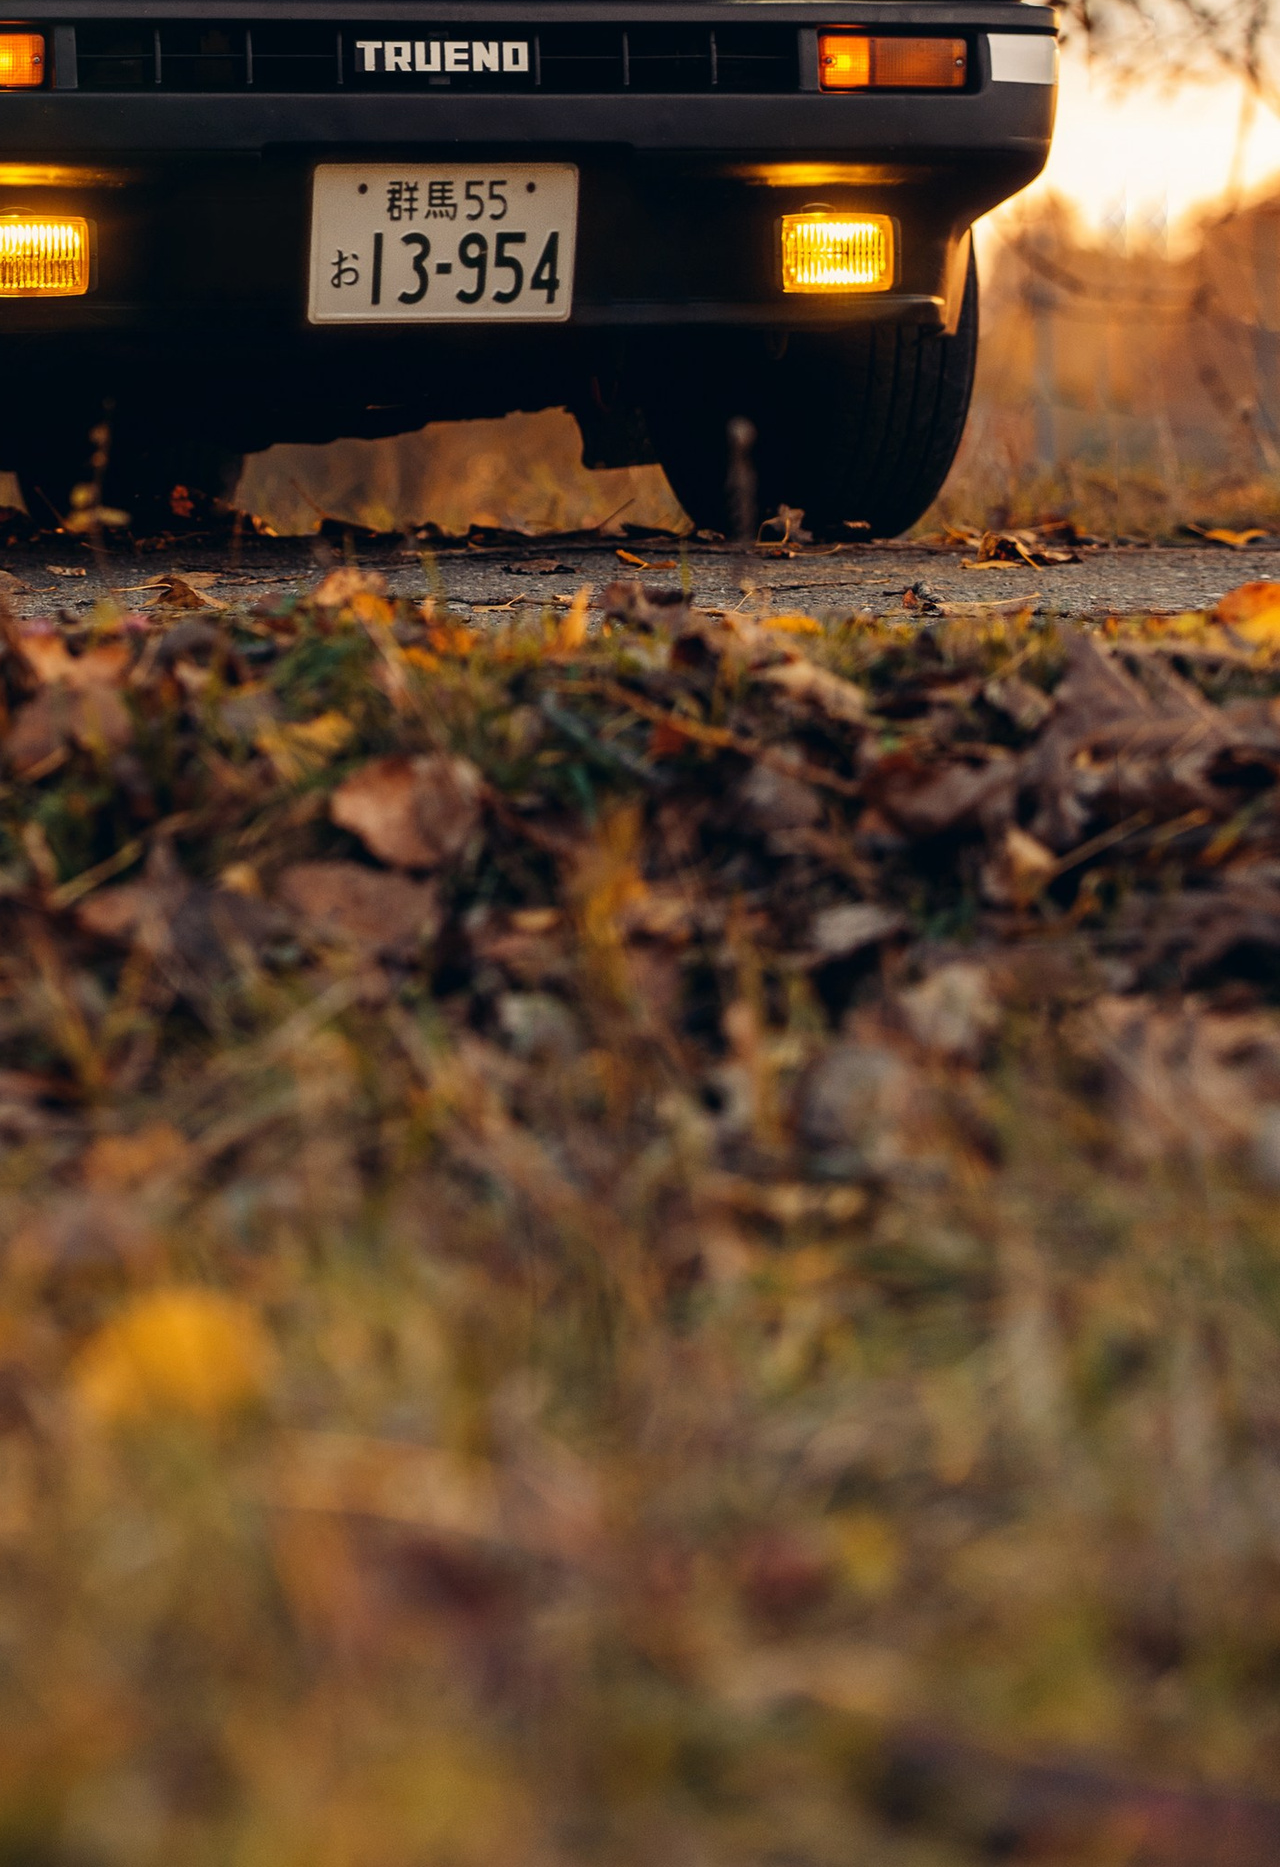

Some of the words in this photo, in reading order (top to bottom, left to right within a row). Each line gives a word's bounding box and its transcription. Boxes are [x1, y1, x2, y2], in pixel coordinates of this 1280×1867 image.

[356, 41, 529, 72] TRUENO
[386, 180, 508, 221] 群馬55
[330, 249, 360, 288] お
[371, 231, 560, 305] 13-954
